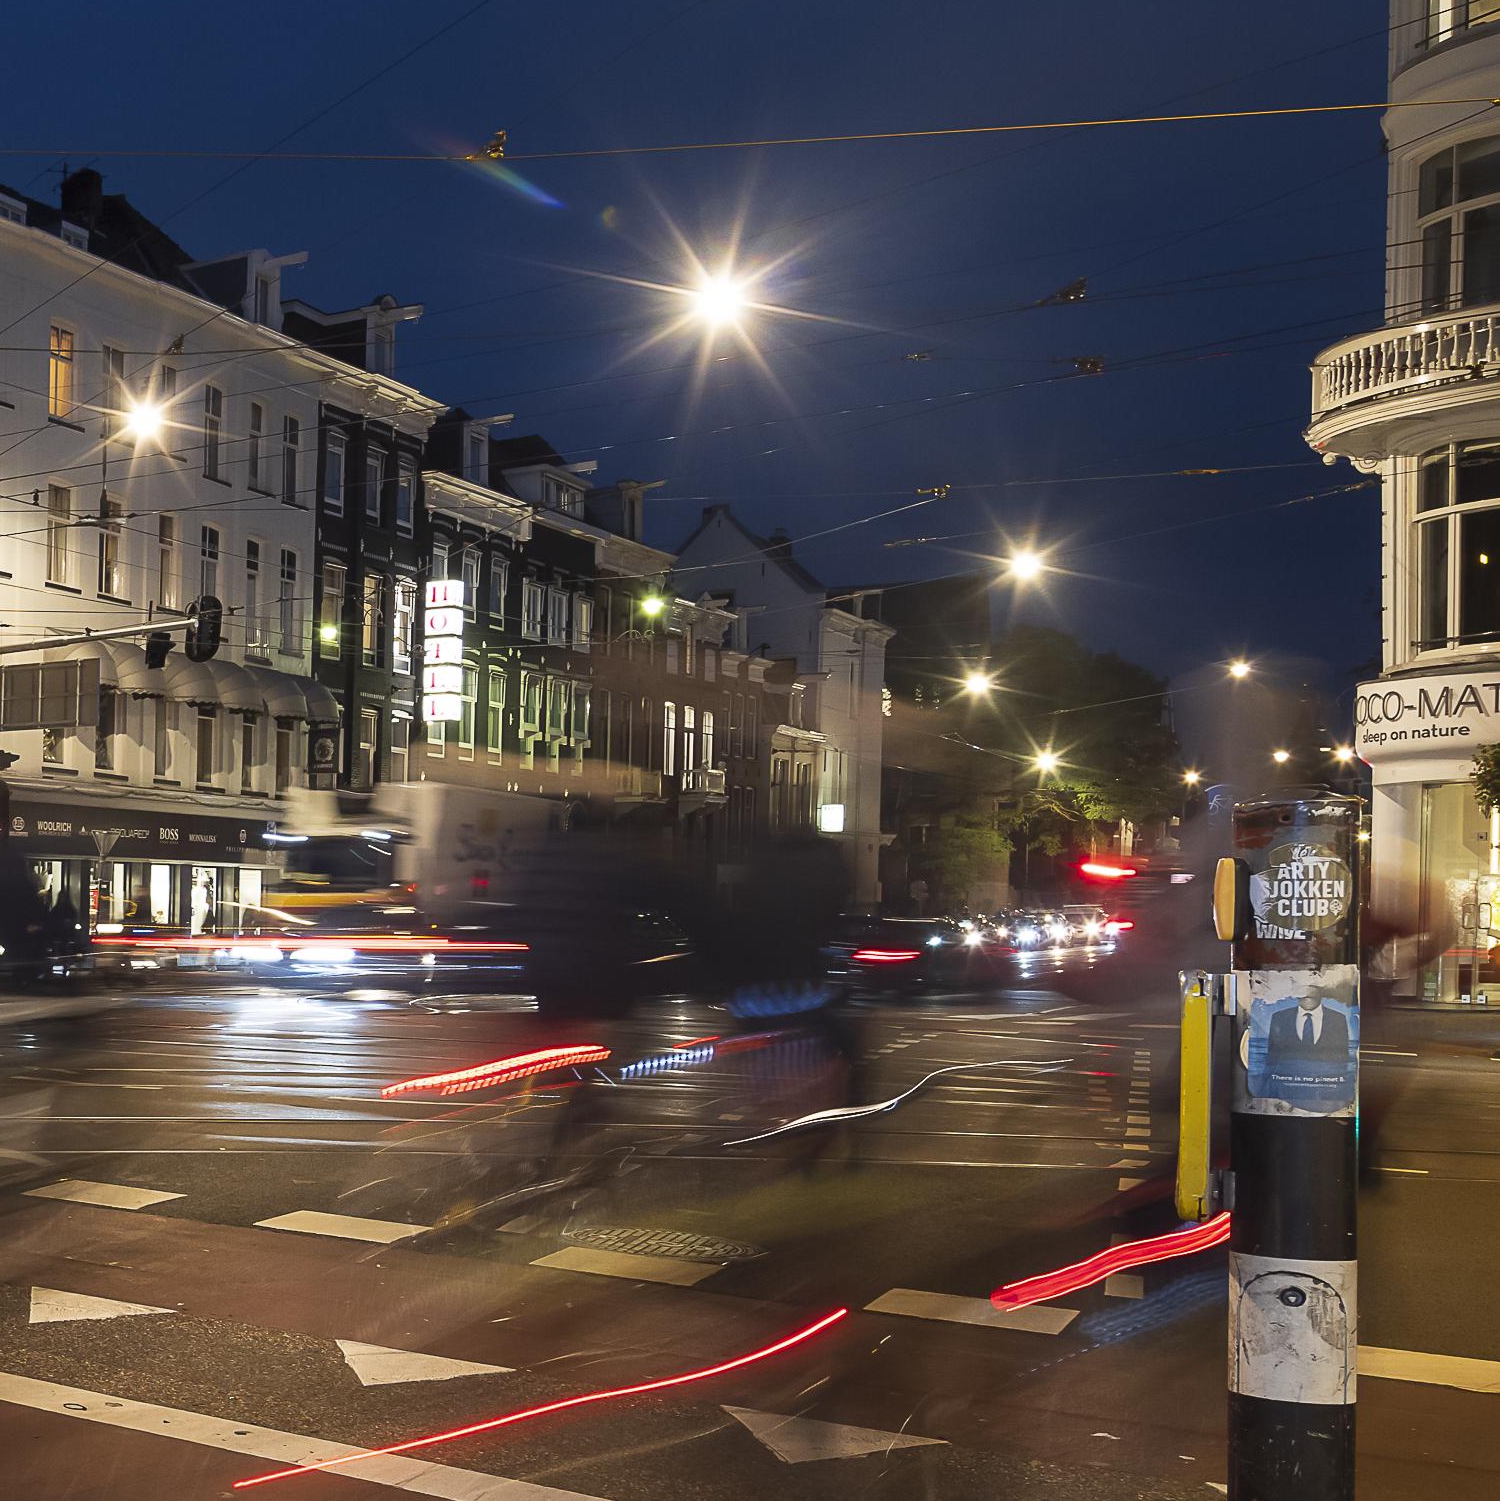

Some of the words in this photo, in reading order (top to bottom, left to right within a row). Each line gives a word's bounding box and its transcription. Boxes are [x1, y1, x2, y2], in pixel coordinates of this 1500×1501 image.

[1362, 729, 1387, 745] sleep
[1390, 731, 1407, 741] on
[1411, 724, 1470, 739] nature
[37, 820, 72, 832] WOOLRICH
[159, 827, 179, 841] BOSS
[1277, 898, 1329, 917] CLUB
